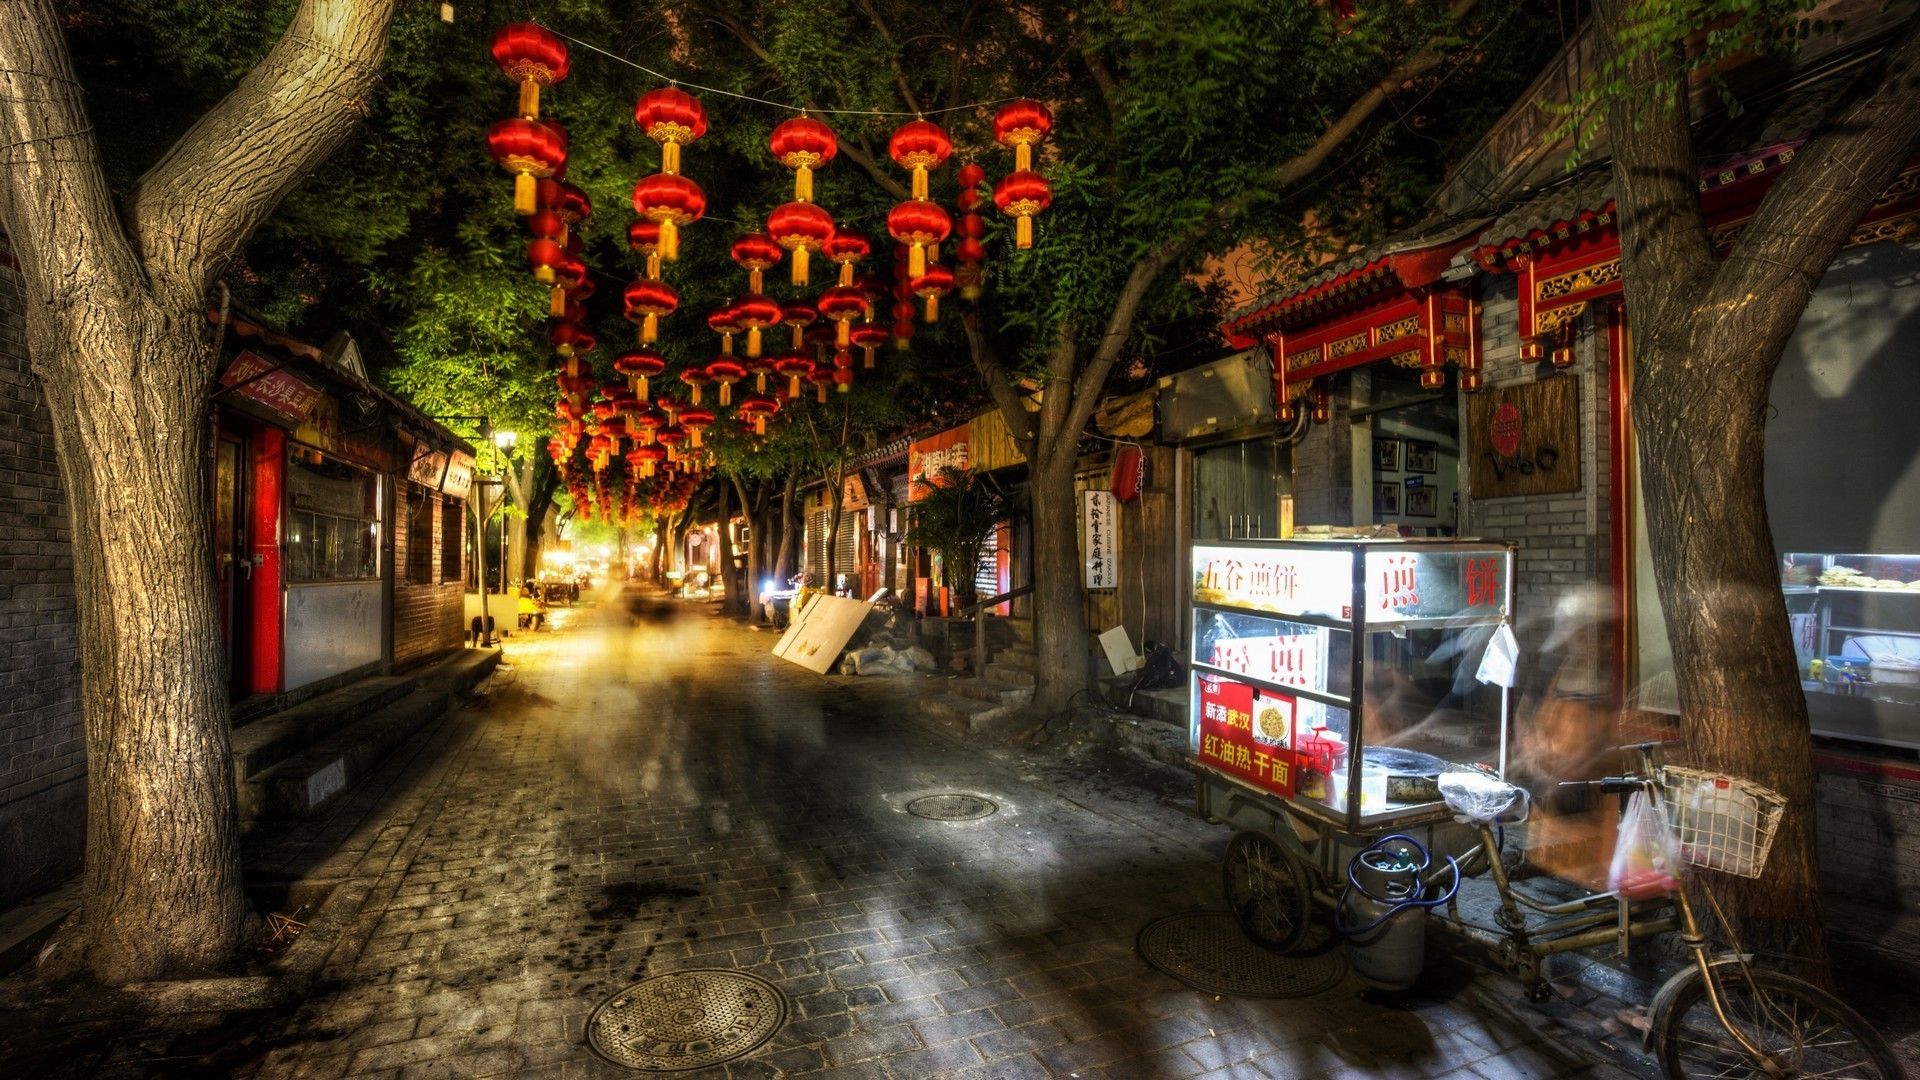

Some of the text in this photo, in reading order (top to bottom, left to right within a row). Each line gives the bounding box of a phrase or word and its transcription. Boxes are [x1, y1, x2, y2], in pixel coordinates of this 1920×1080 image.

[1205, 559, 1298, 600] 五谷煎饼
[1205, 701, 1250, 731] 新添武汉
[1204, 733, 1289, 787] 红油热干面
